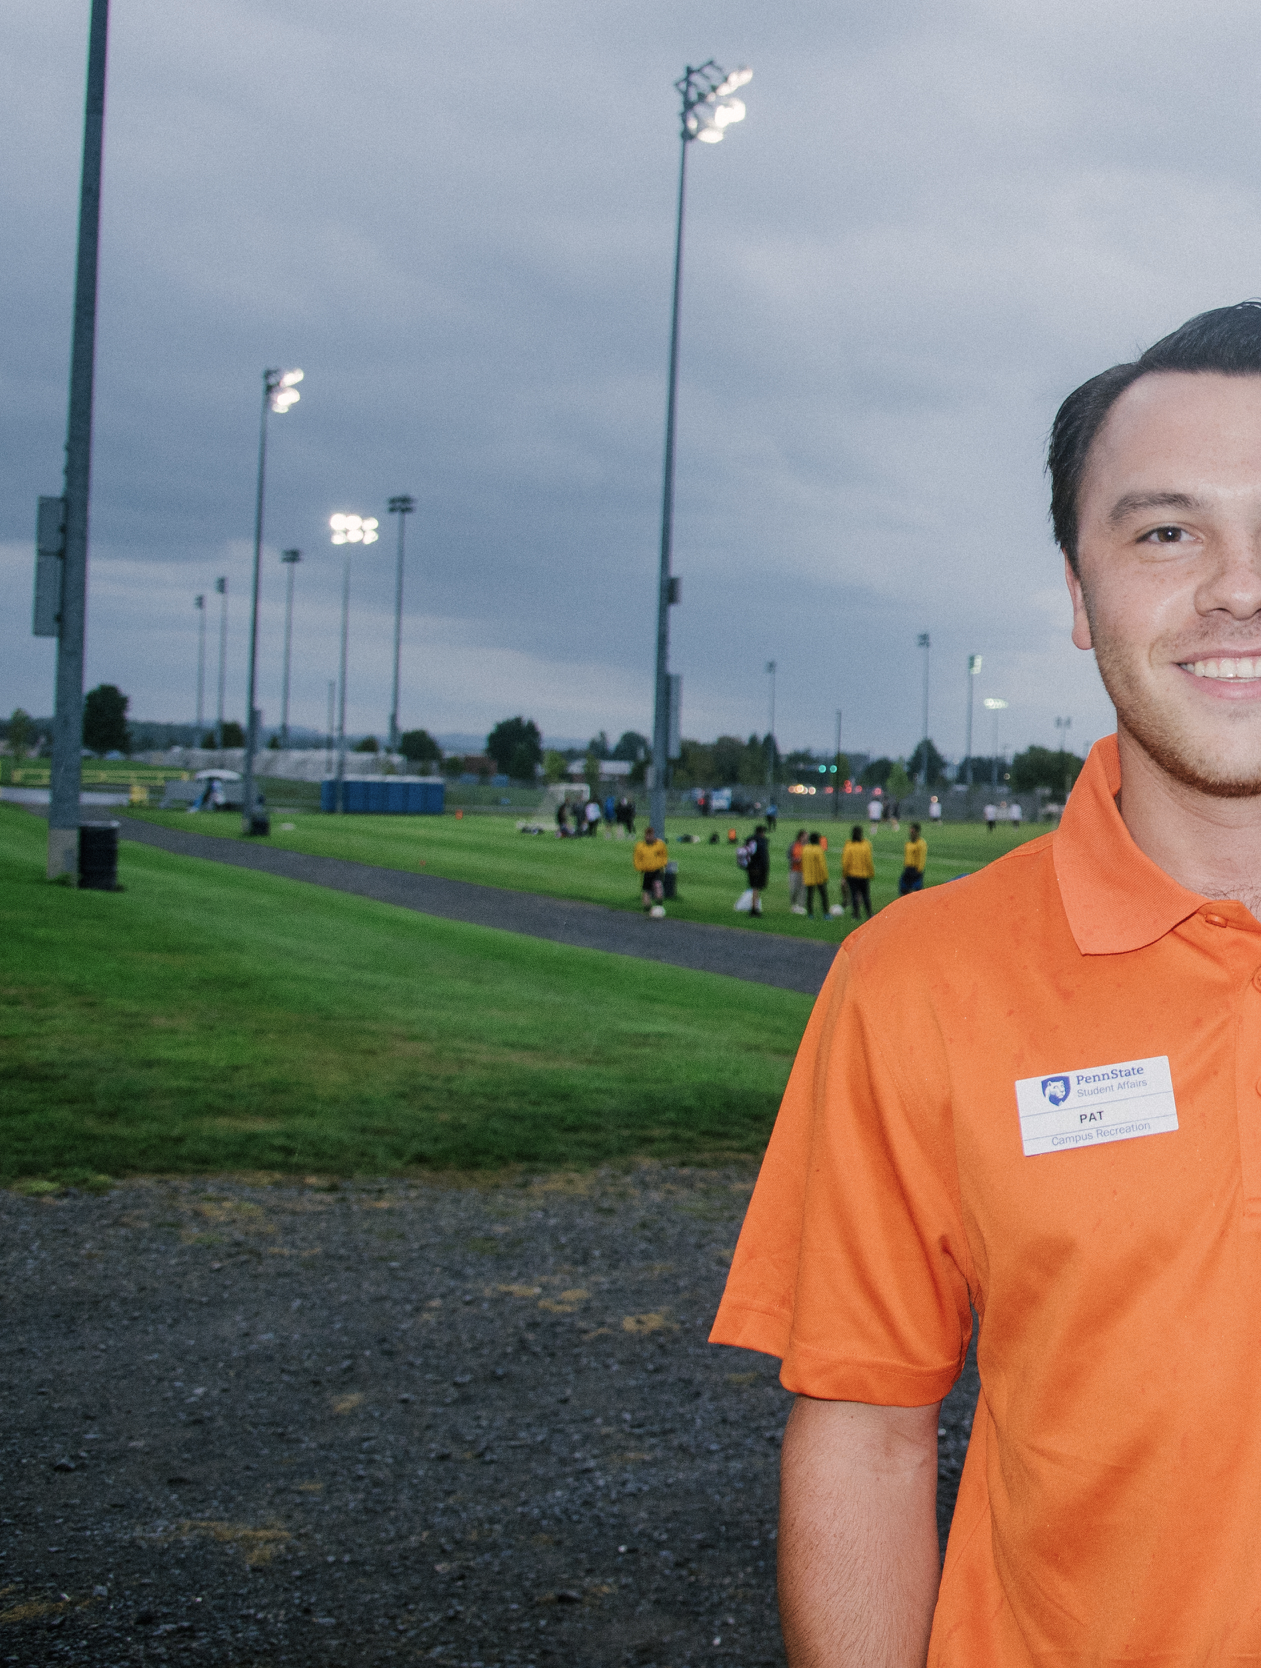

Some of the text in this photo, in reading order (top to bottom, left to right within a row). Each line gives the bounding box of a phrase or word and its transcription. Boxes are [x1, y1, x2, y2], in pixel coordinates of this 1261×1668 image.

[1076, 1066, 1144, 1085] PennState
[1077, 1078, 1148, 1098] Student Affairs
[1079, 1110, 1104, 1124] PAT
[1051, 1122, 1151, 1146] Campus Recreation
